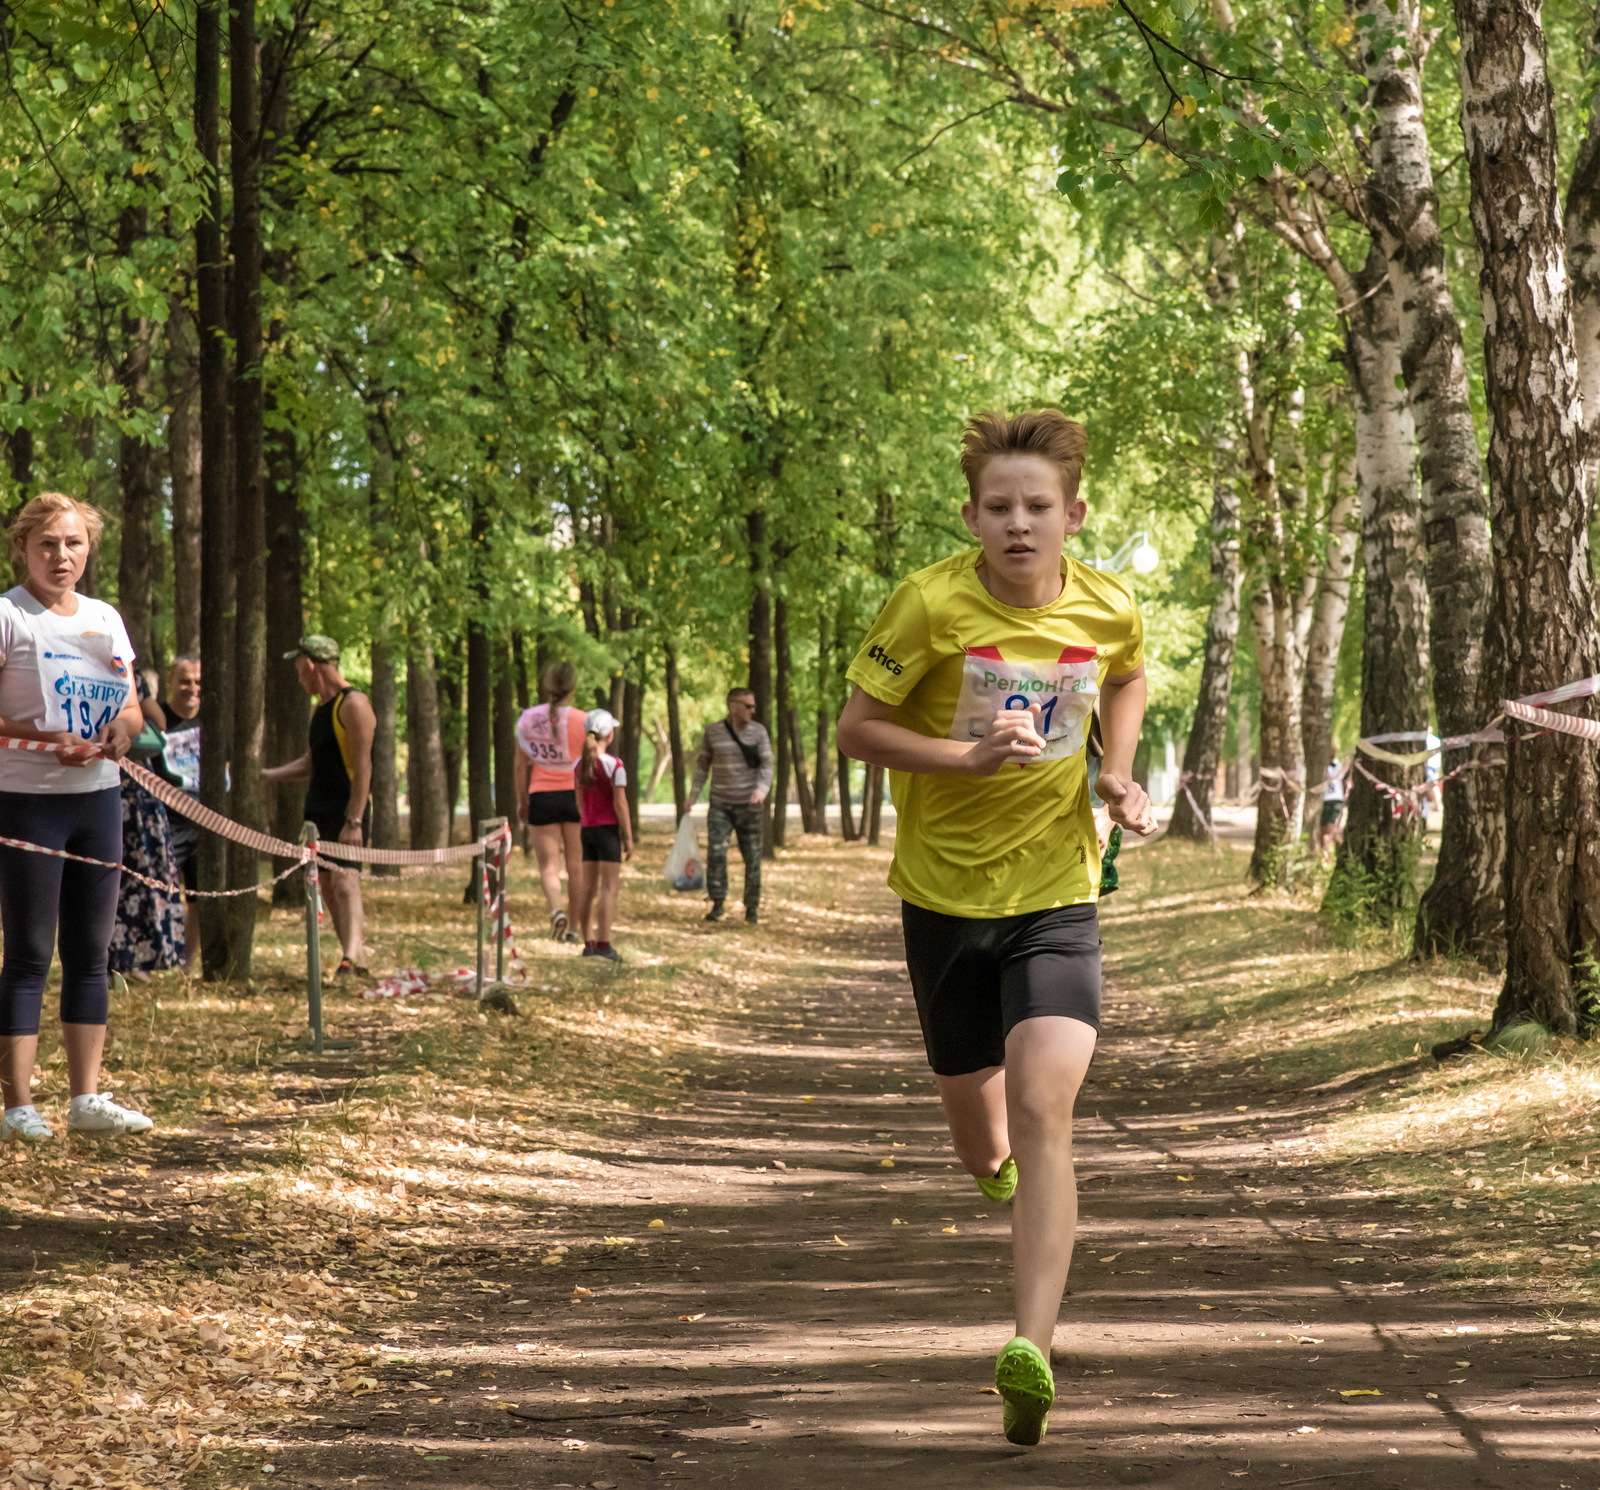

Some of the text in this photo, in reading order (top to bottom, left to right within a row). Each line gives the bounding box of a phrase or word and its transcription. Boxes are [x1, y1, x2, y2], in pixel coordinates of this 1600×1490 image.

[874, 649, 904, 675] ПСБ
[72, 681, 127, 704] ГАЗПРО
[984, 671, 1088, 693] РегионГаз
